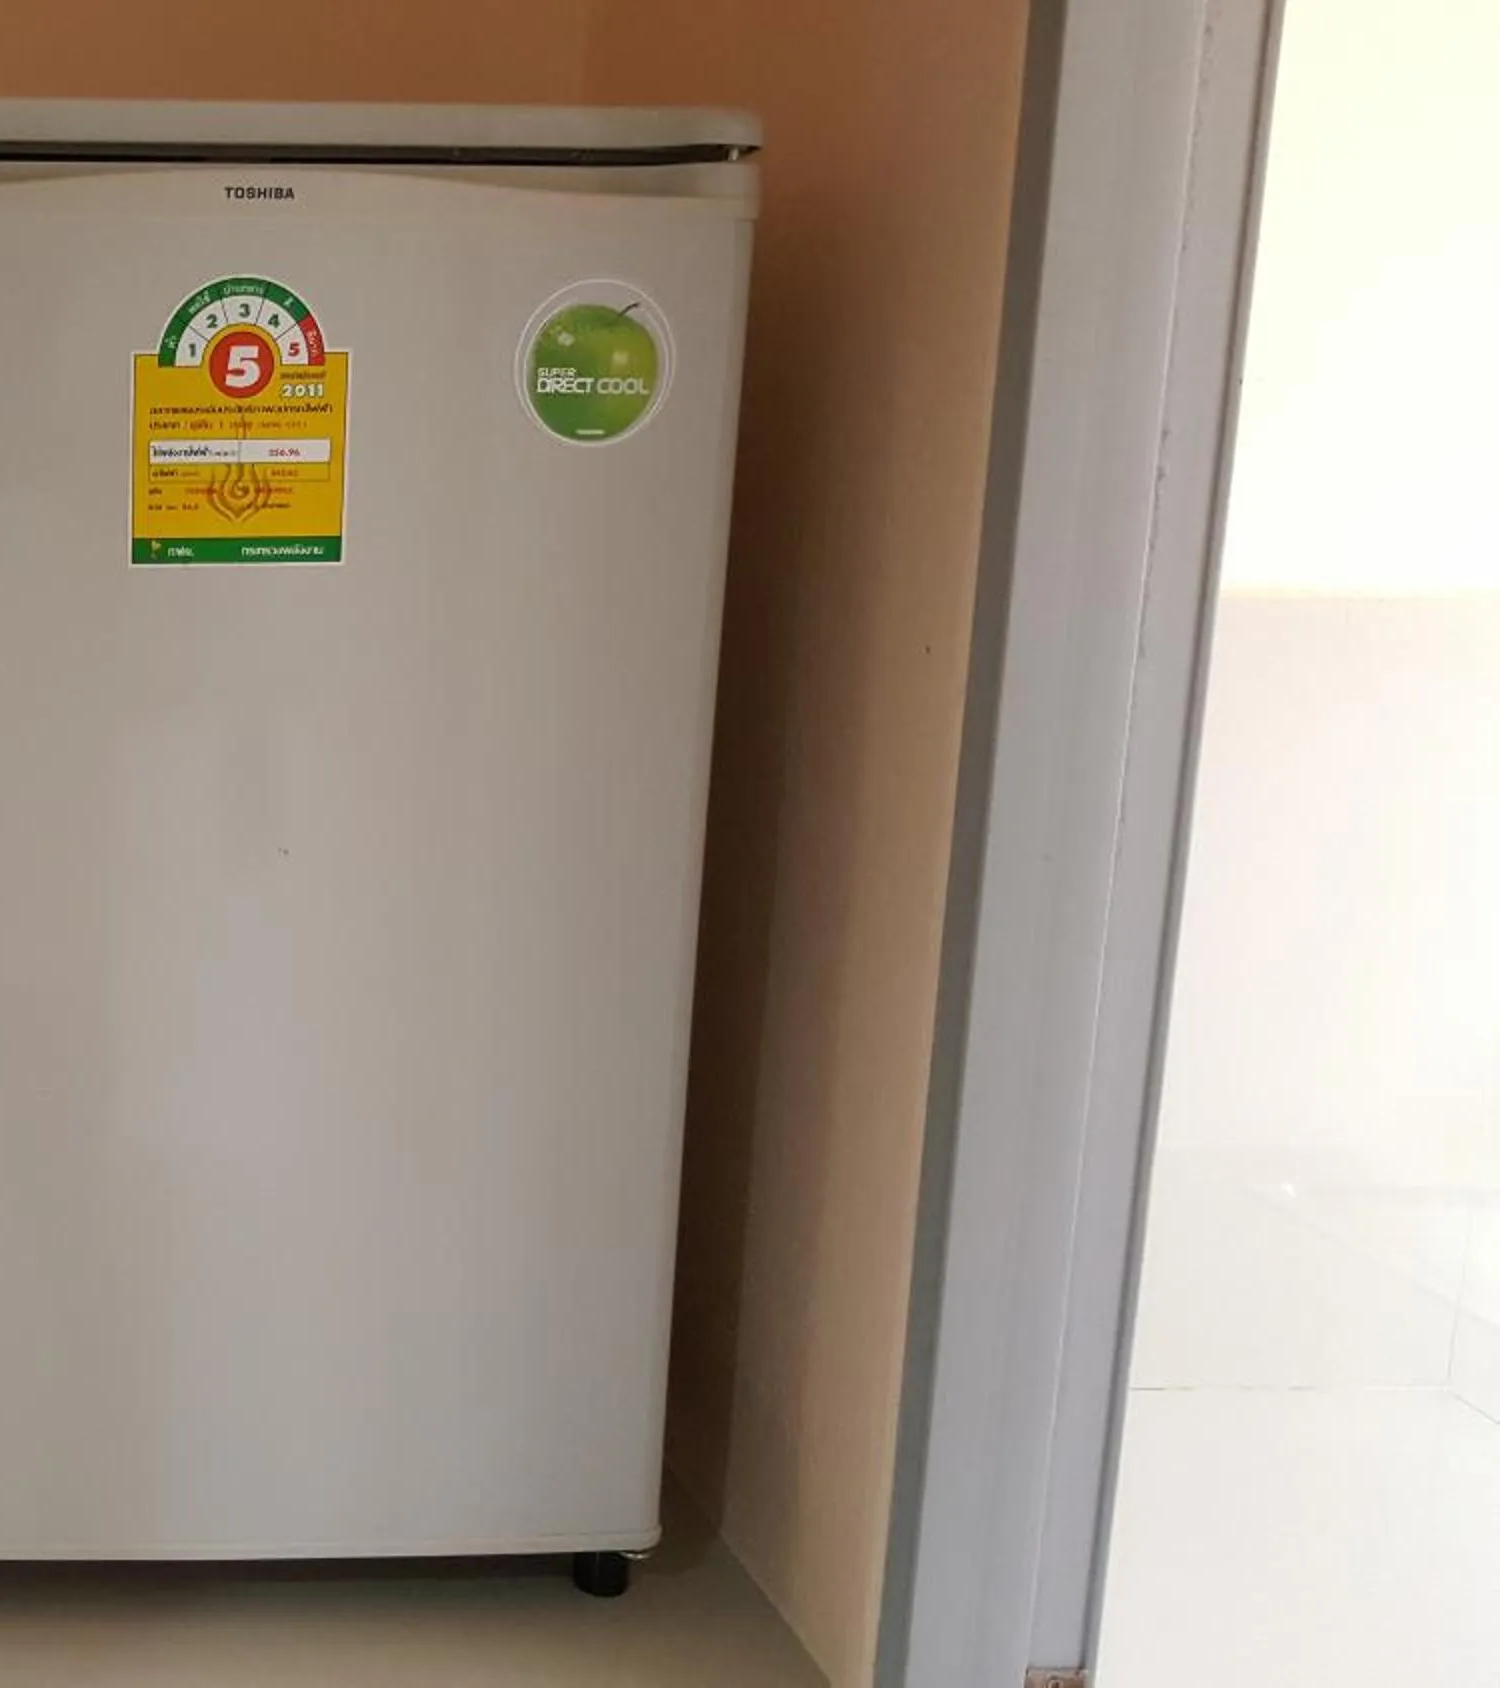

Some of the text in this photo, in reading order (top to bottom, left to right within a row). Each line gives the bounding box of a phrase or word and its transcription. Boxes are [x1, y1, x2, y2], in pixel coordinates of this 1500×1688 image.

[224, 186, 295, 200] TOSHIBA
[188, 303, 301, 358] 1 2 3 4 5
[225, 345, 261, 388] 5
[537, 367, 577, 377] SUPER
[282, 383, 324, 398] 2011
[537, 378, 650, 395] DIRECT COOL
